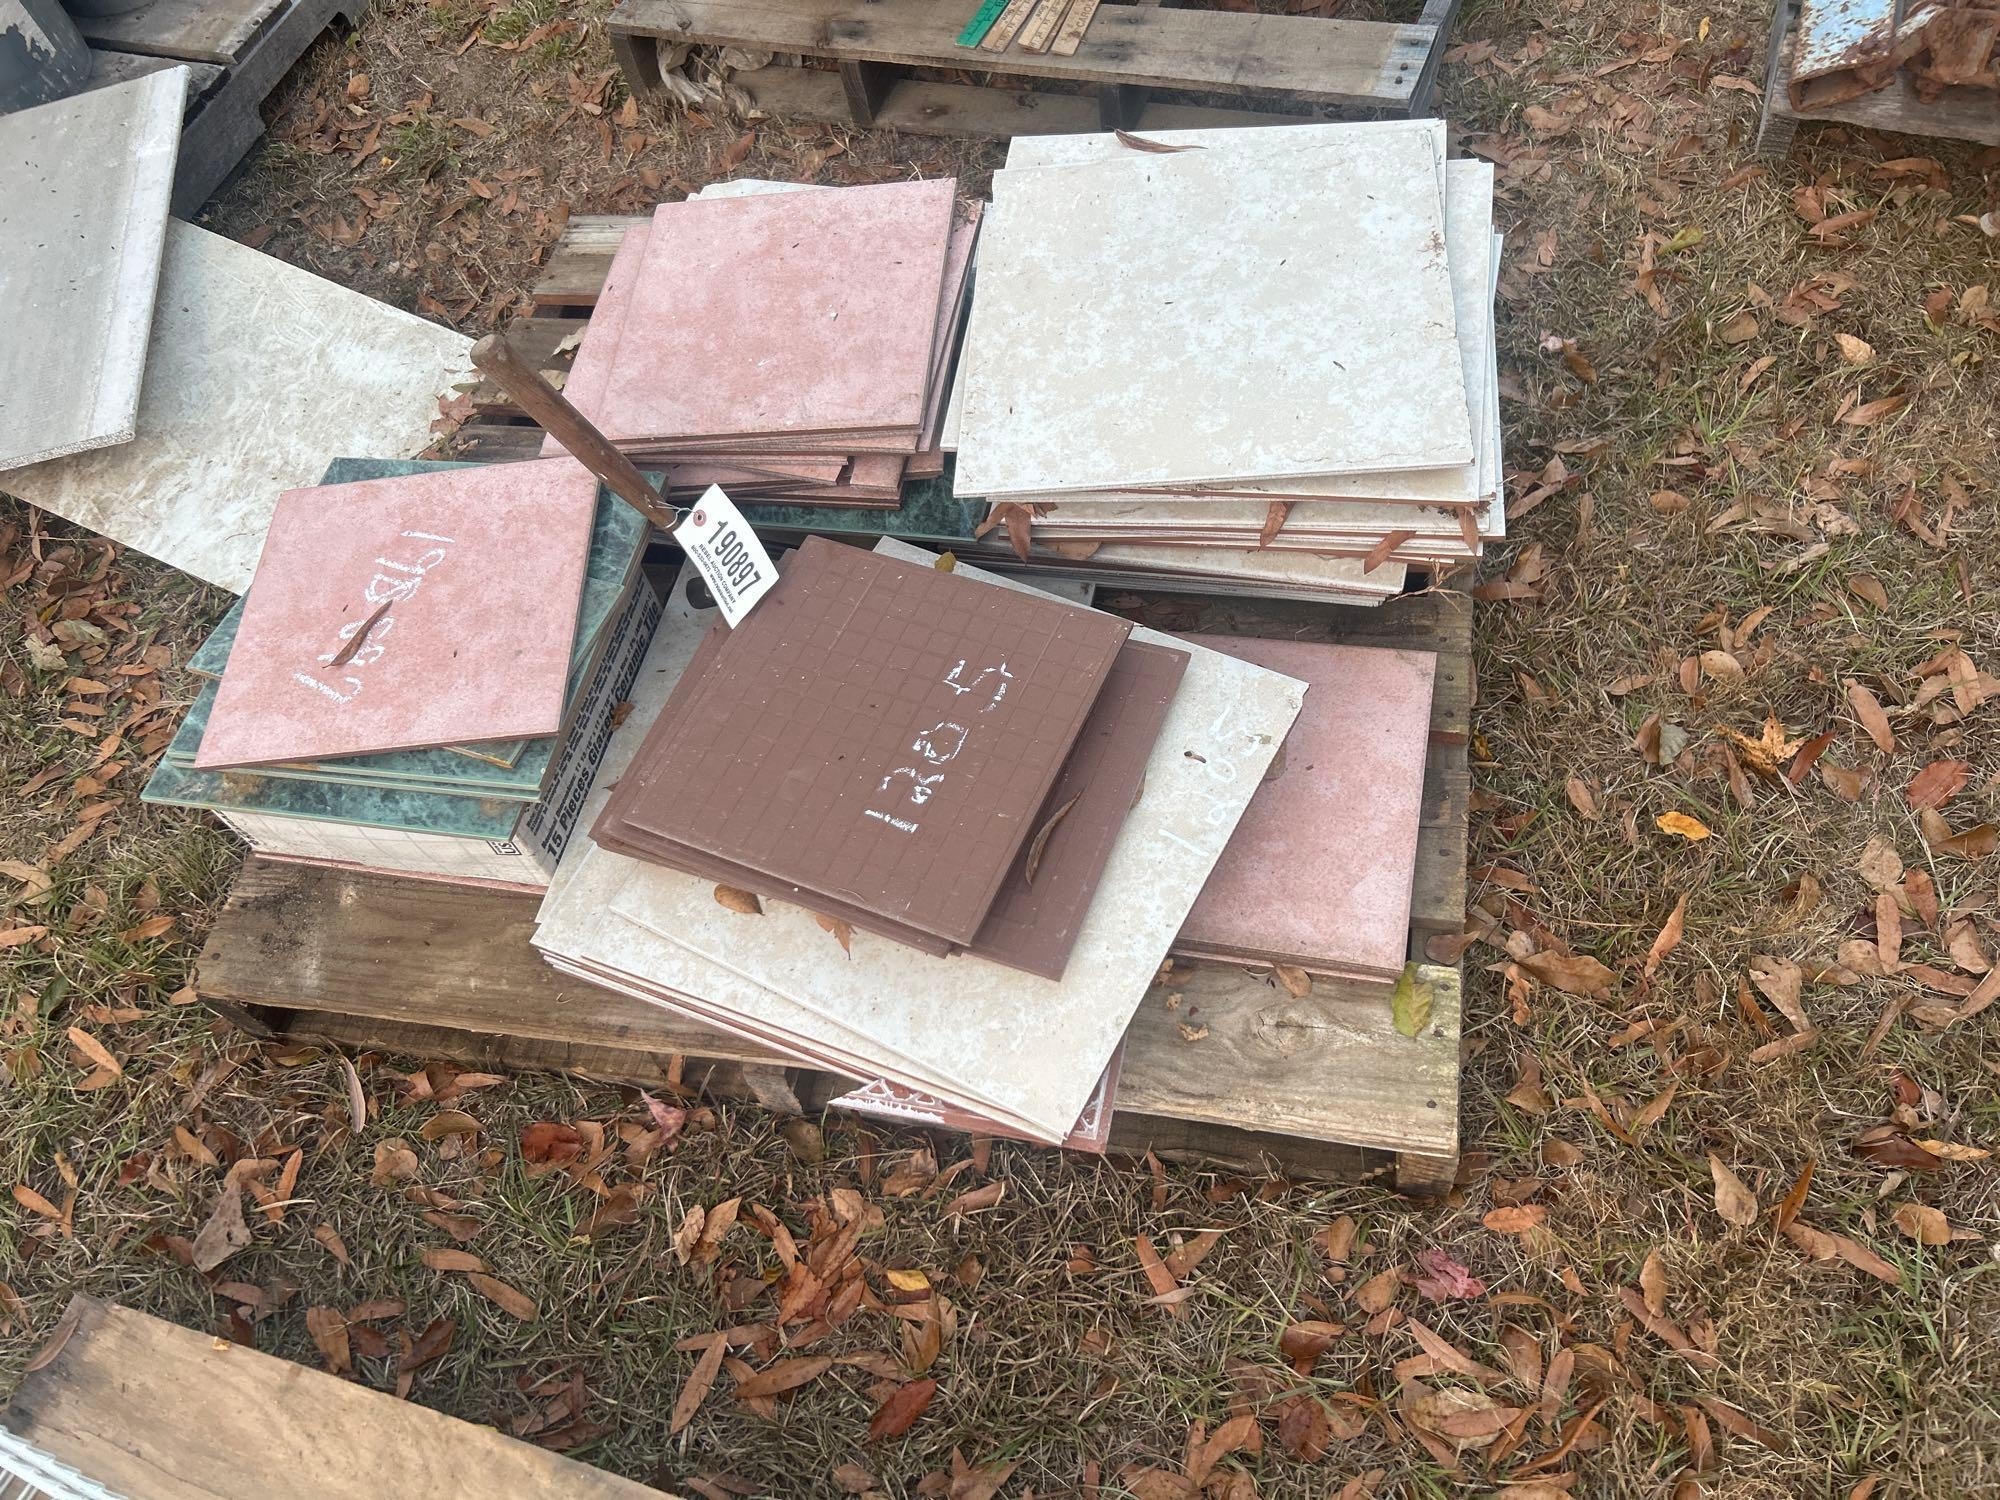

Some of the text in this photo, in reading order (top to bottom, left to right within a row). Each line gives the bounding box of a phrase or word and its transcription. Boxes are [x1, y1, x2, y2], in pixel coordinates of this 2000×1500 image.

[699, 543, 737, 604] REBEL AUCTION COMPANY
[708, 520, 761, 596] 190897
[545, 828, 563, 861] 15
[558, 763, 590, 832] Pieces
[613, 631, 646, 704] Ceramic
[642, 598, 659, 633] Tile
[864, 660, 1014, 834] 1205
